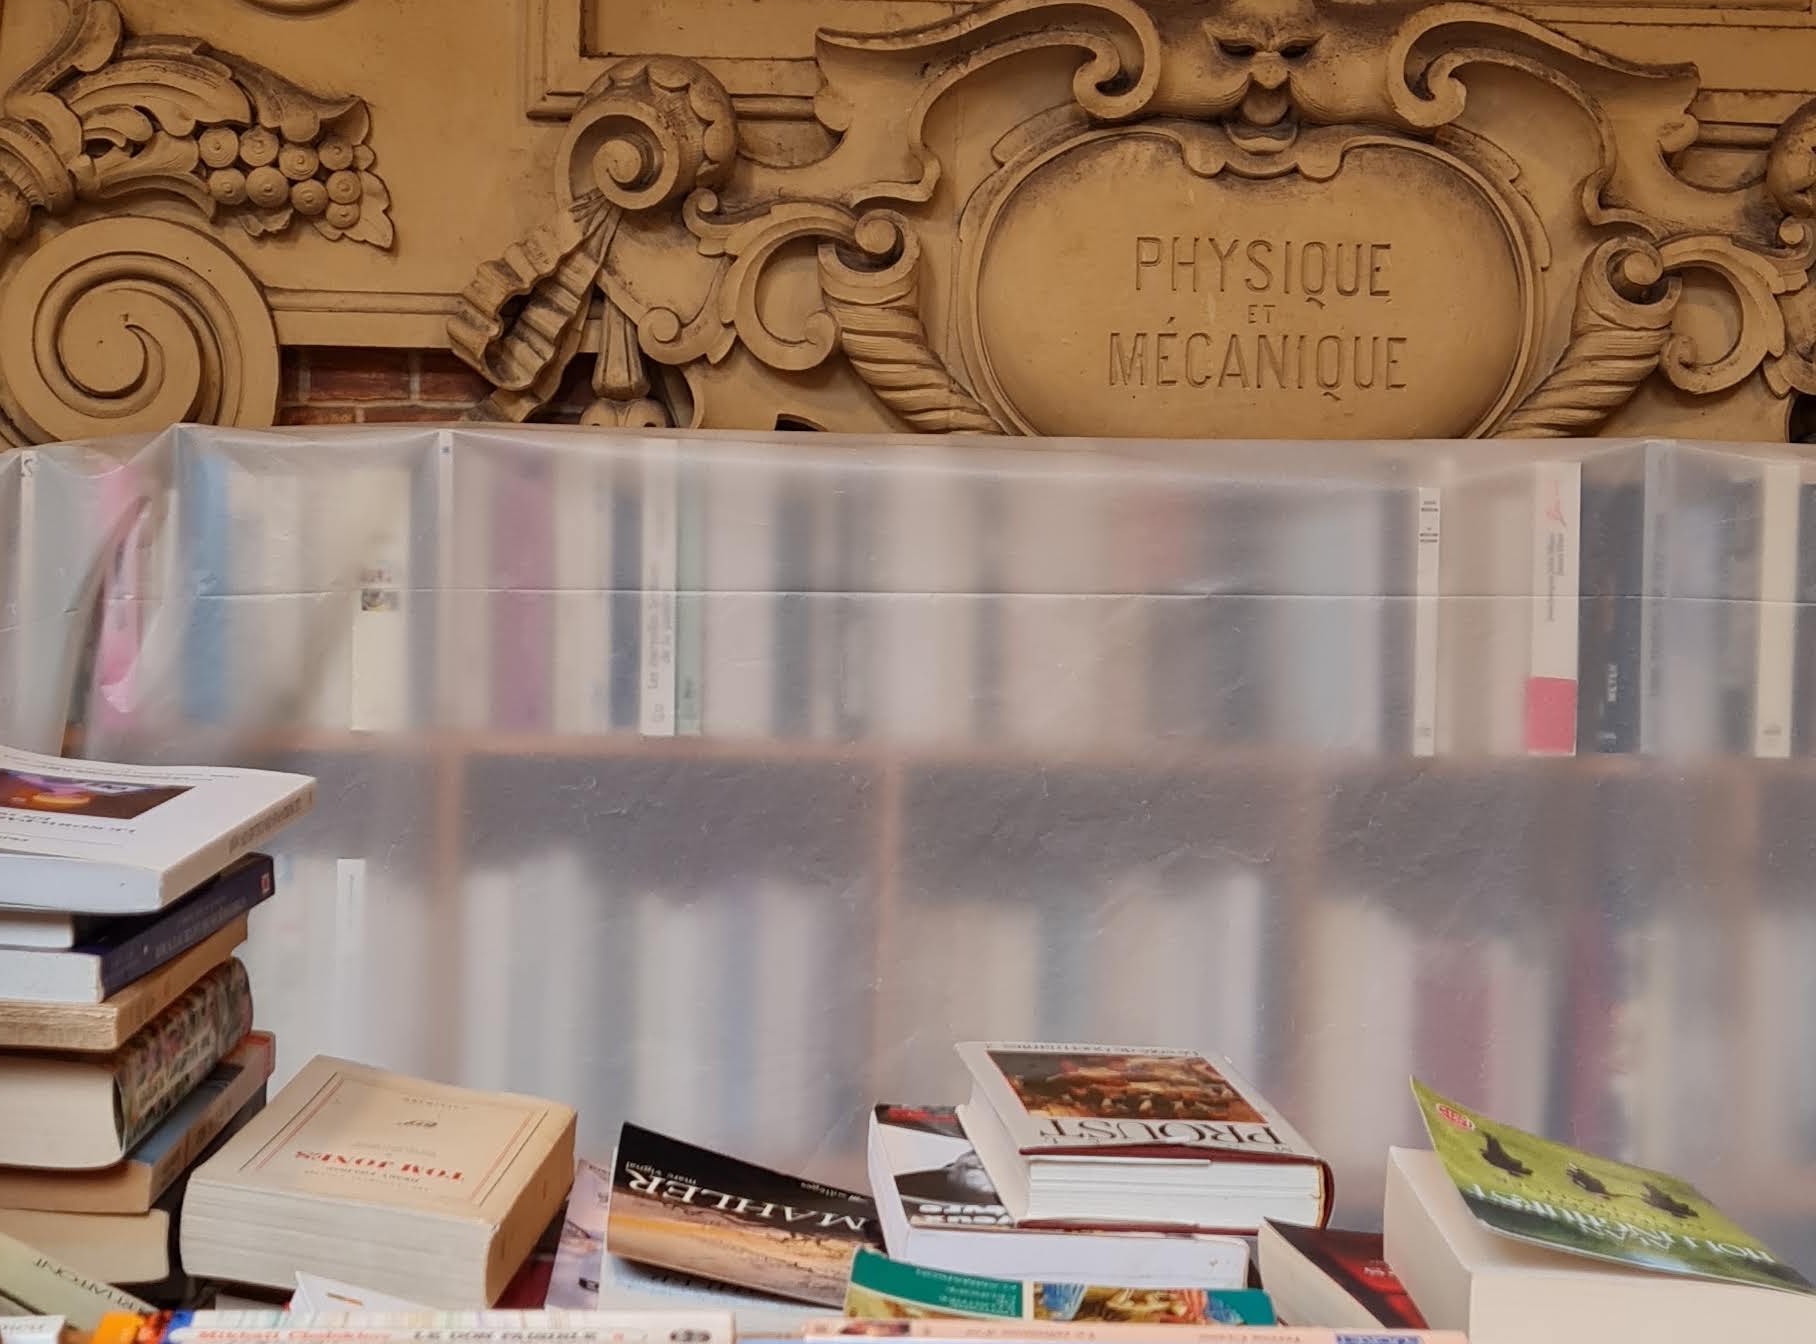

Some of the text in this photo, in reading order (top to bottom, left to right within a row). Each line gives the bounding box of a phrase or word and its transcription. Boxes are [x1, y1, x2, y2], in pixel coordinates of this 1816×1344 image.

[1135, 235, 1393, 310] PHYSIQUE
[1247, 303, 1277, 325] ET
[1108, 315, 1408, 402] MÉCANIQUE
[1038, 1118, 1285, 1147] PROUST
[294, 1150, 396, 1170] JONES
[401, 1163, 466, 1183] TOM
[625, 1167, 868, 1231] MAHLER
